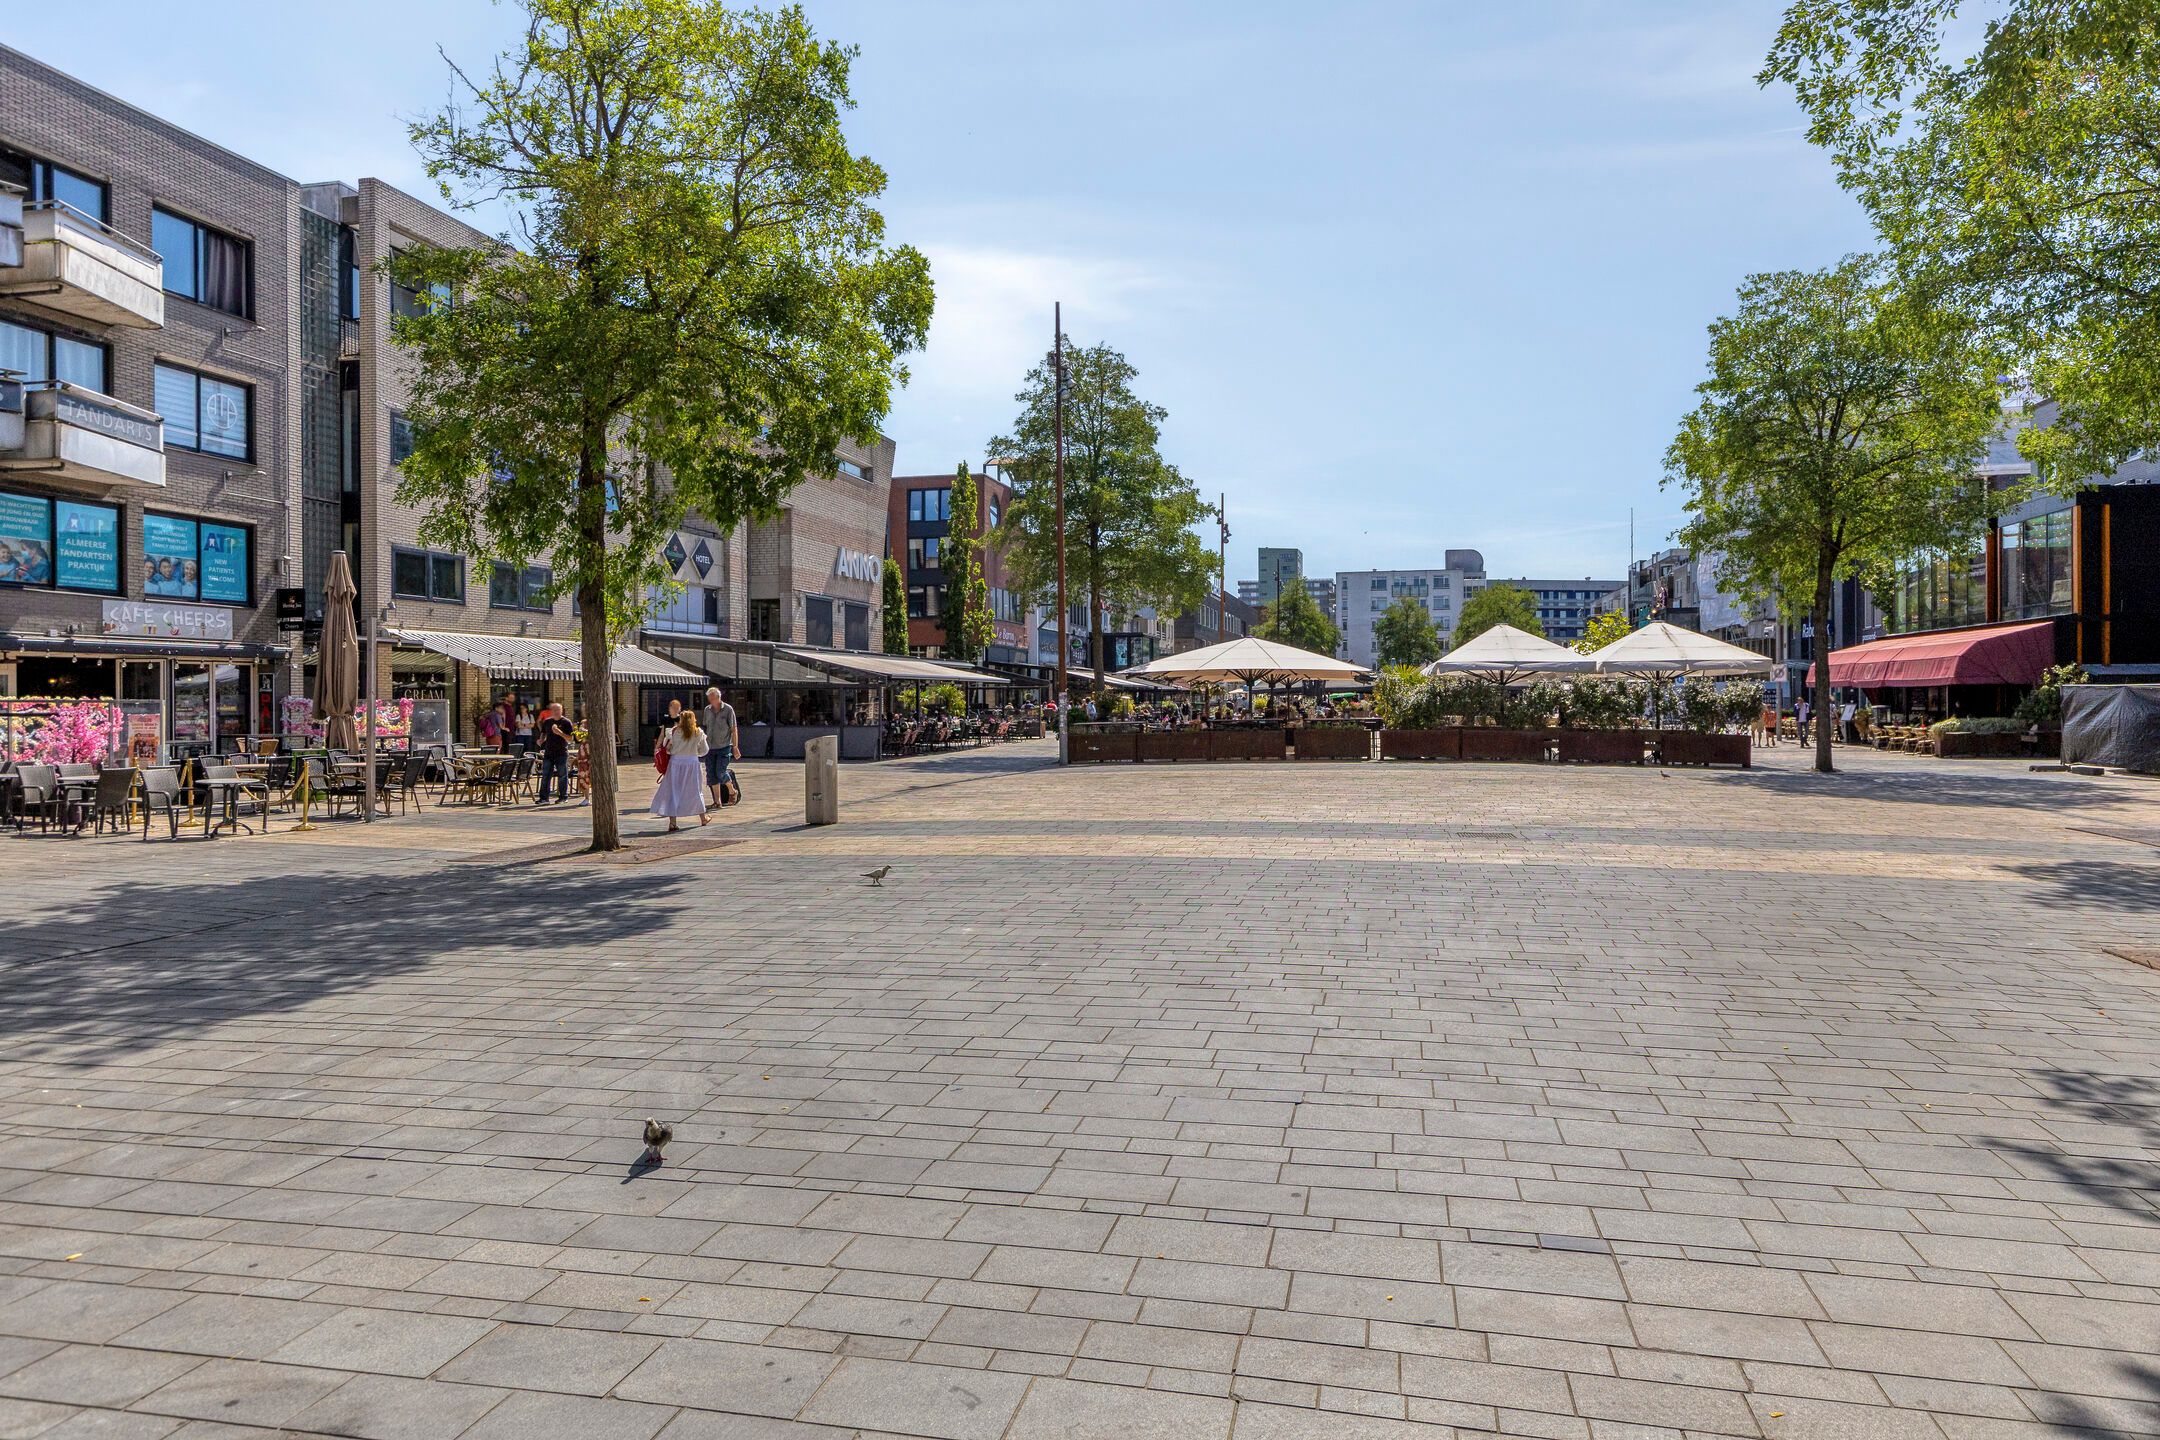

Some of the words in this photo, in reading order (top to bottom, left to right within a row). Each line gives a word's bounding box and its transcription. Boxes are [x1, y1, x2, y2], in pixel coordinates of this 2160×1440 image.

[65, 399, 153, 441] TANDARTS
[65, 538, 107, 550] ALMEERSE
[60, 548, 113, 561] TANDARTSEN
[695, 554, 711, 565] HOTEL
[67, 560, 105, 572] PRAKTIJK
[834, 545, 881, 583] ANNO
[208, 566, 235, 575] PATIENTS
[207, 575, 236, 584] WELCOME
[162, 610, 226, 628] CHEERS
[404, 689, 444, 700] CREAM
